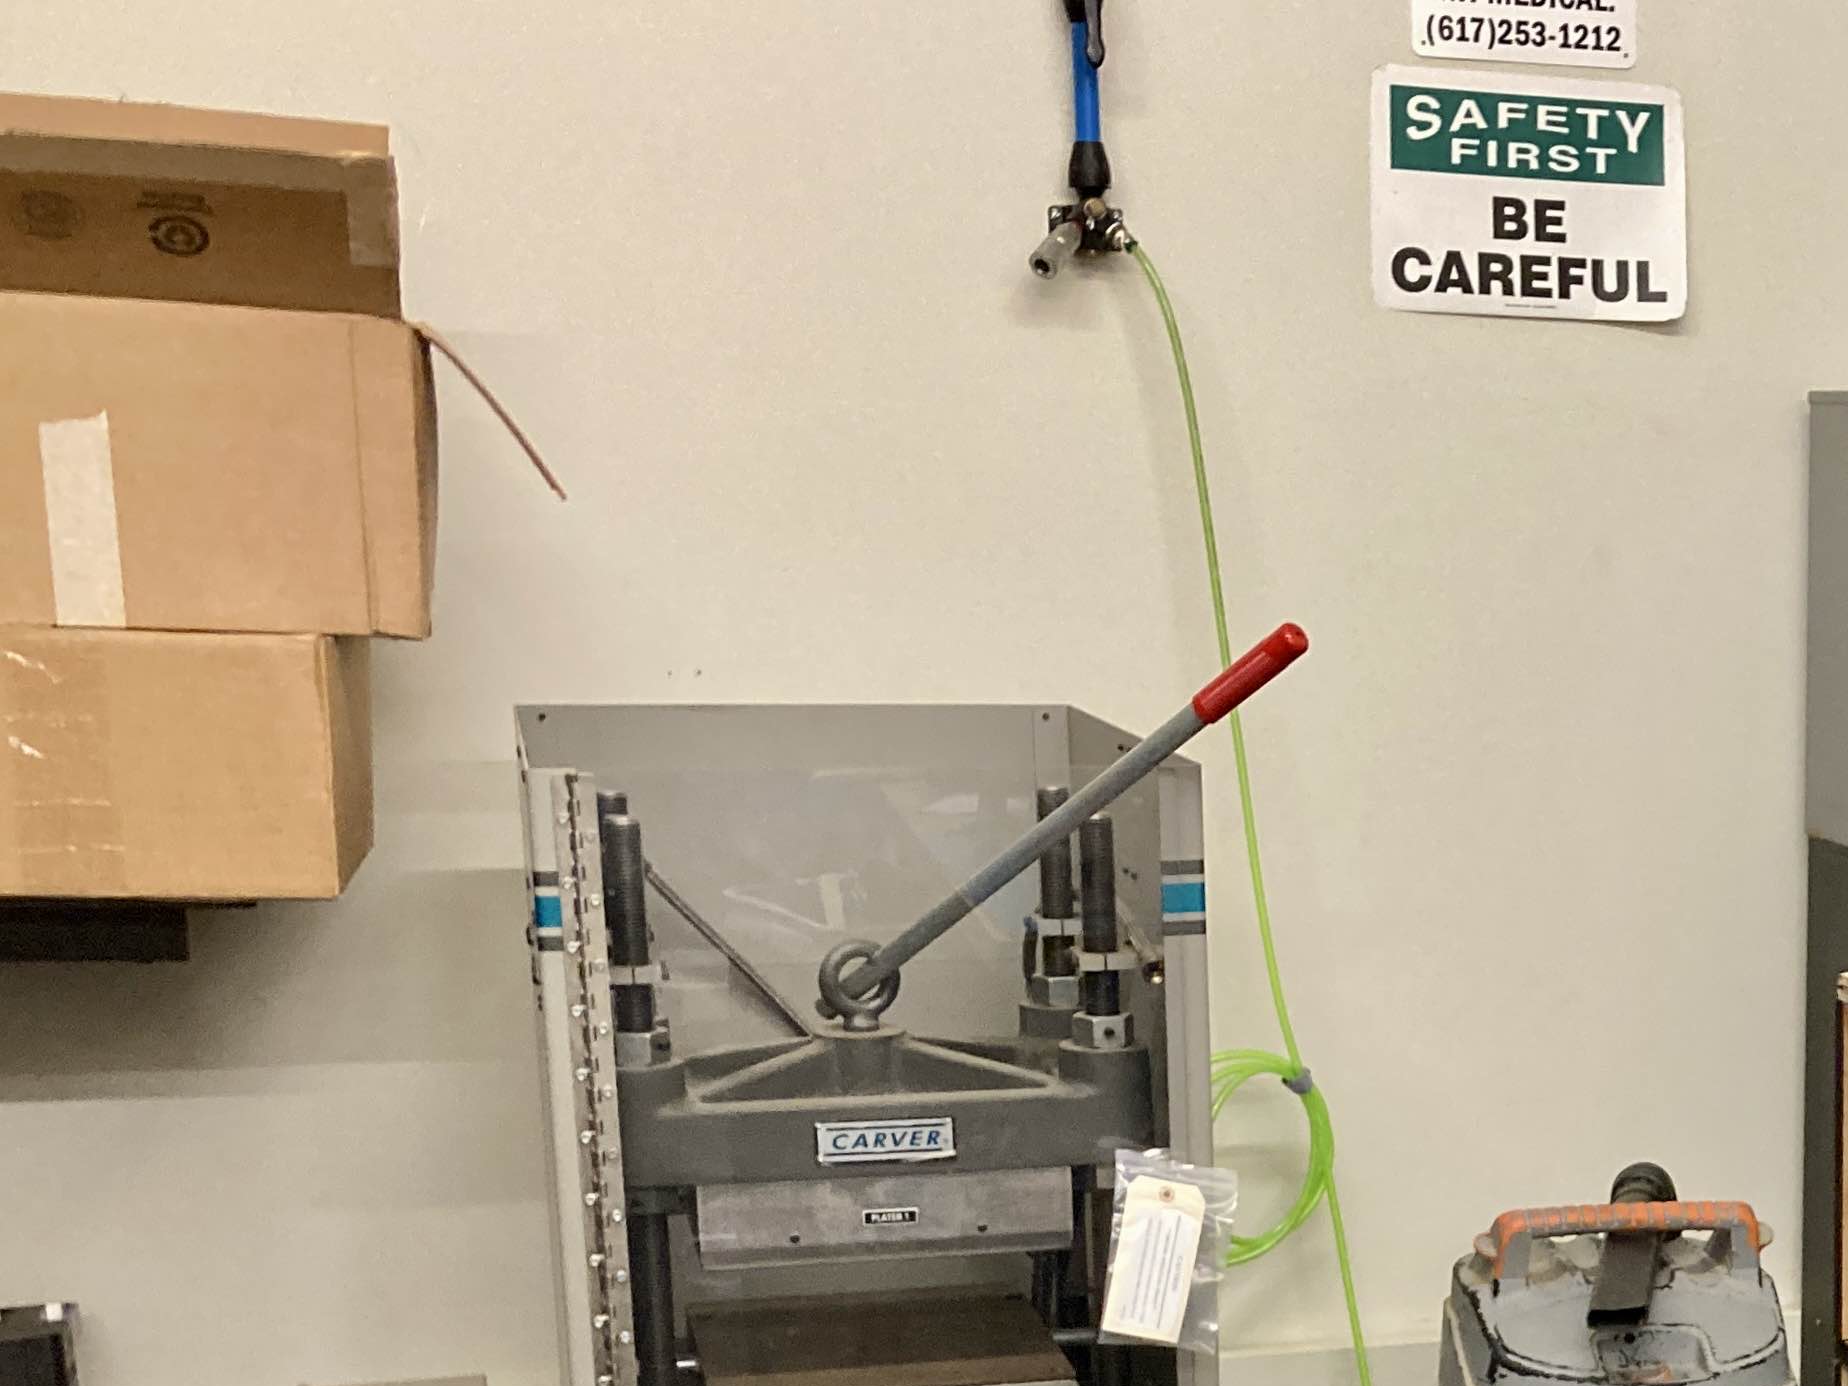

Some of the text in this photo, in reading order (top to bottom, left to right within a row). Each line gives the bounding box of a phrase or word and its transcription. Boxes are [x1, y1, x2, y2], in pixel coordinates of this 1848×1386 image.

[1426, 14, 1622, 51] (617)253-1212
[1406, 94, 1651, 153] SAFETY
[1450, 137, 1617, 175] FIRST
[1492, 196, 1567, 243] BE
[1391, 246, 1668, 303] CAREFUL
[832, 1130, 941, 1150] CARVER
